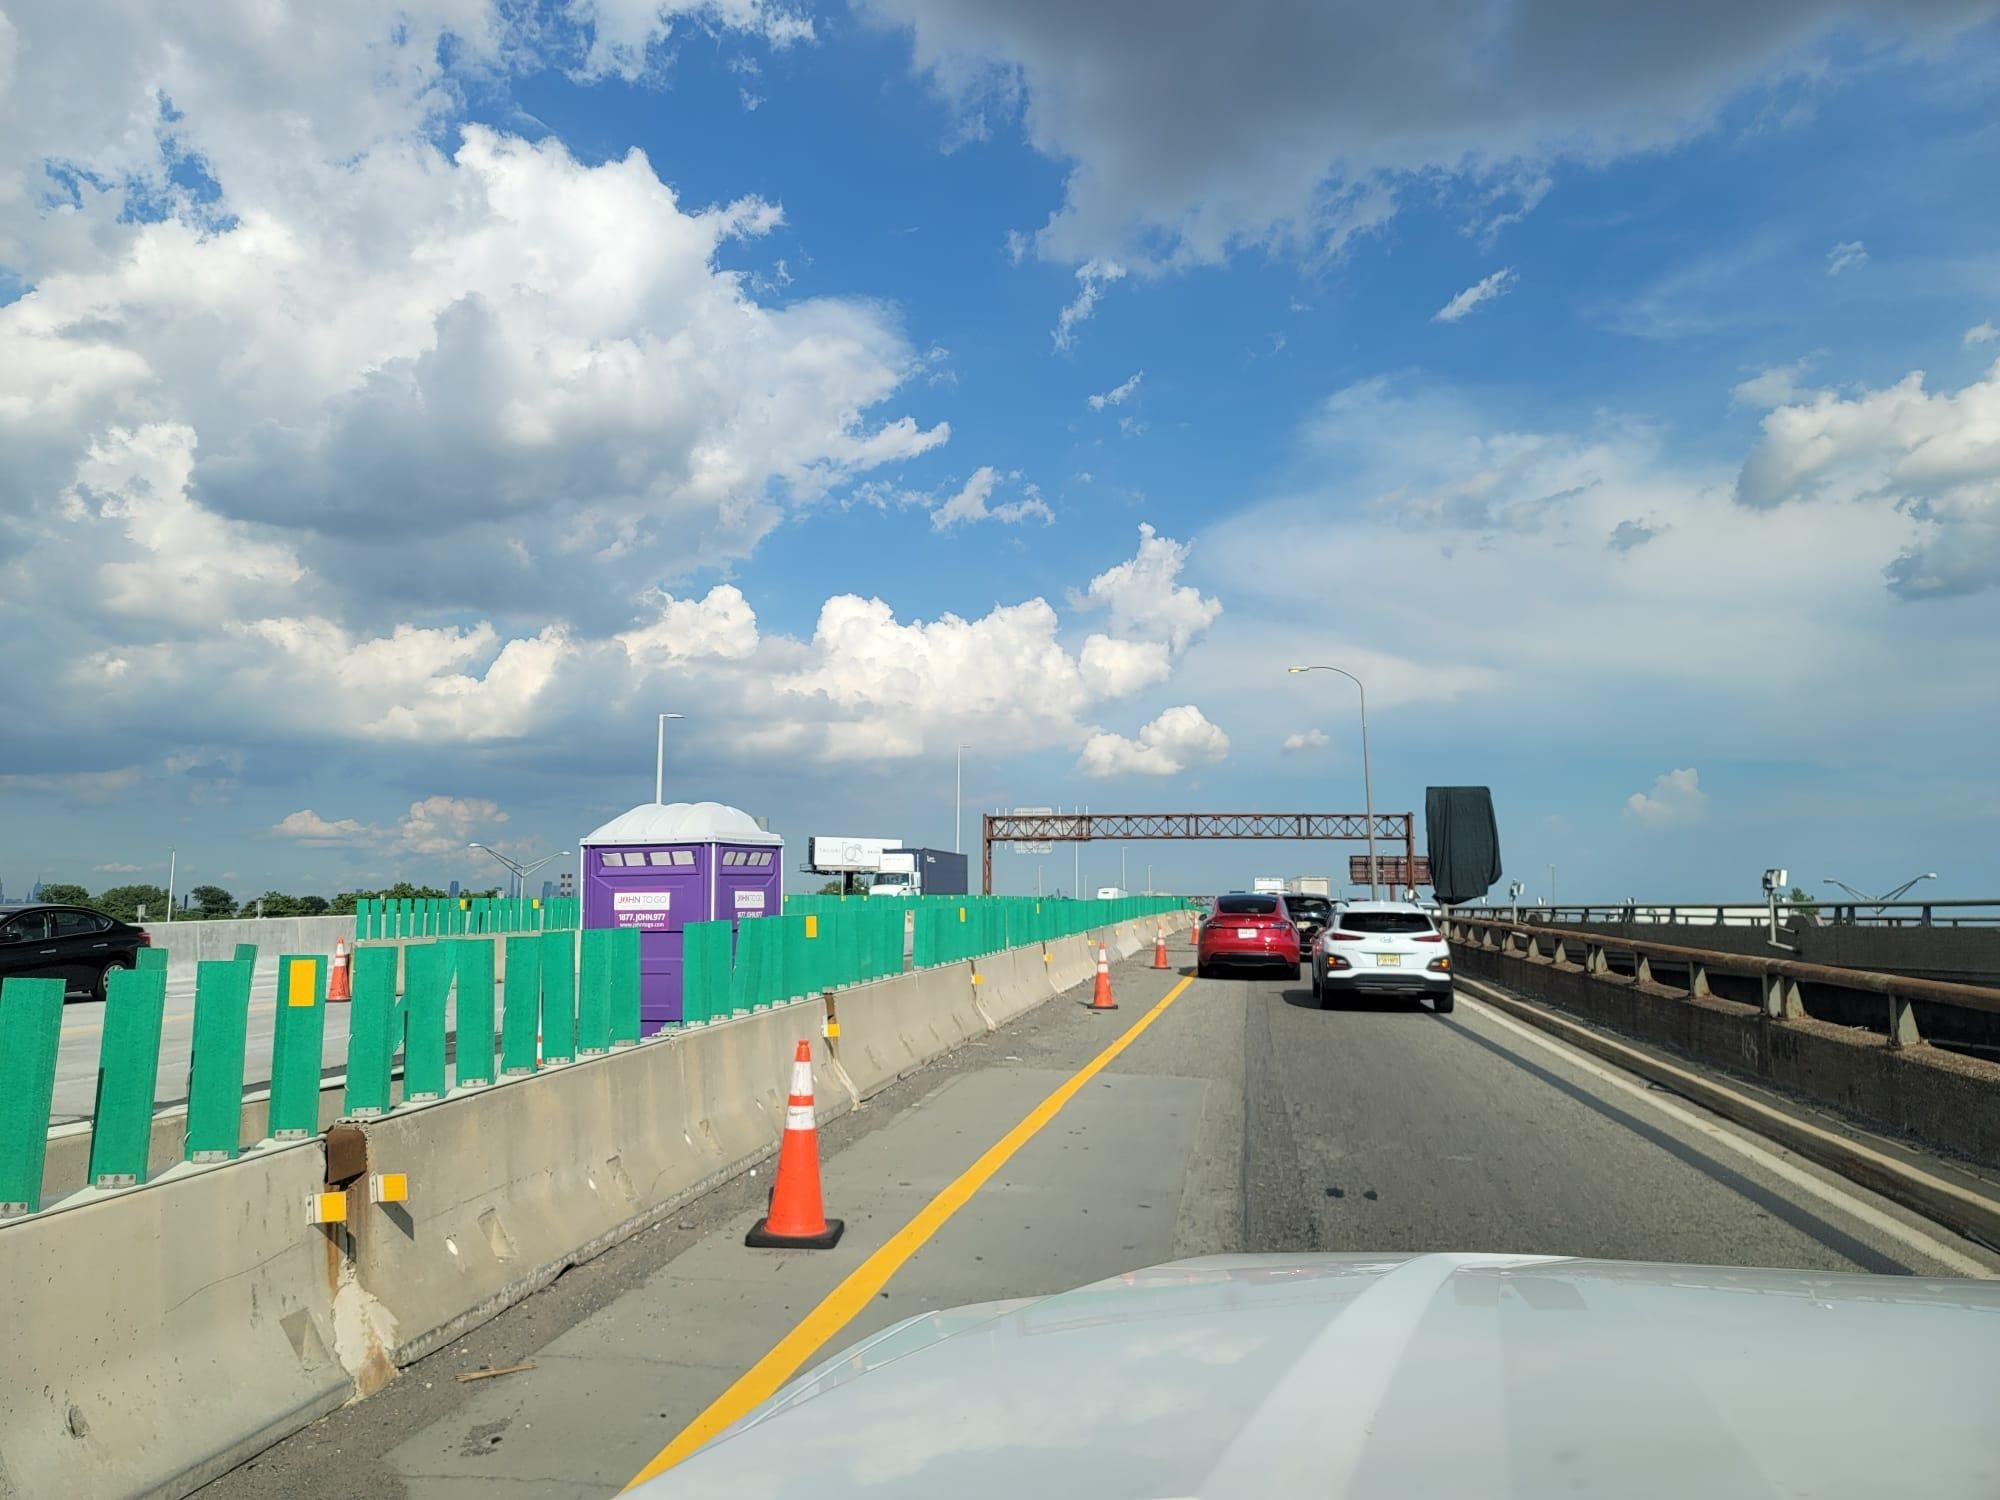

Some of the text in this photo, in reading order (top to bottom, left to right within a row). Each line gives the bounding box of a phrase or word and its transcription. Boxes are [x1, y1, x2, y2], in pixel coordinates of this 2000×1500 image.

[618, 895, 667, 904] JOHN TO GO
